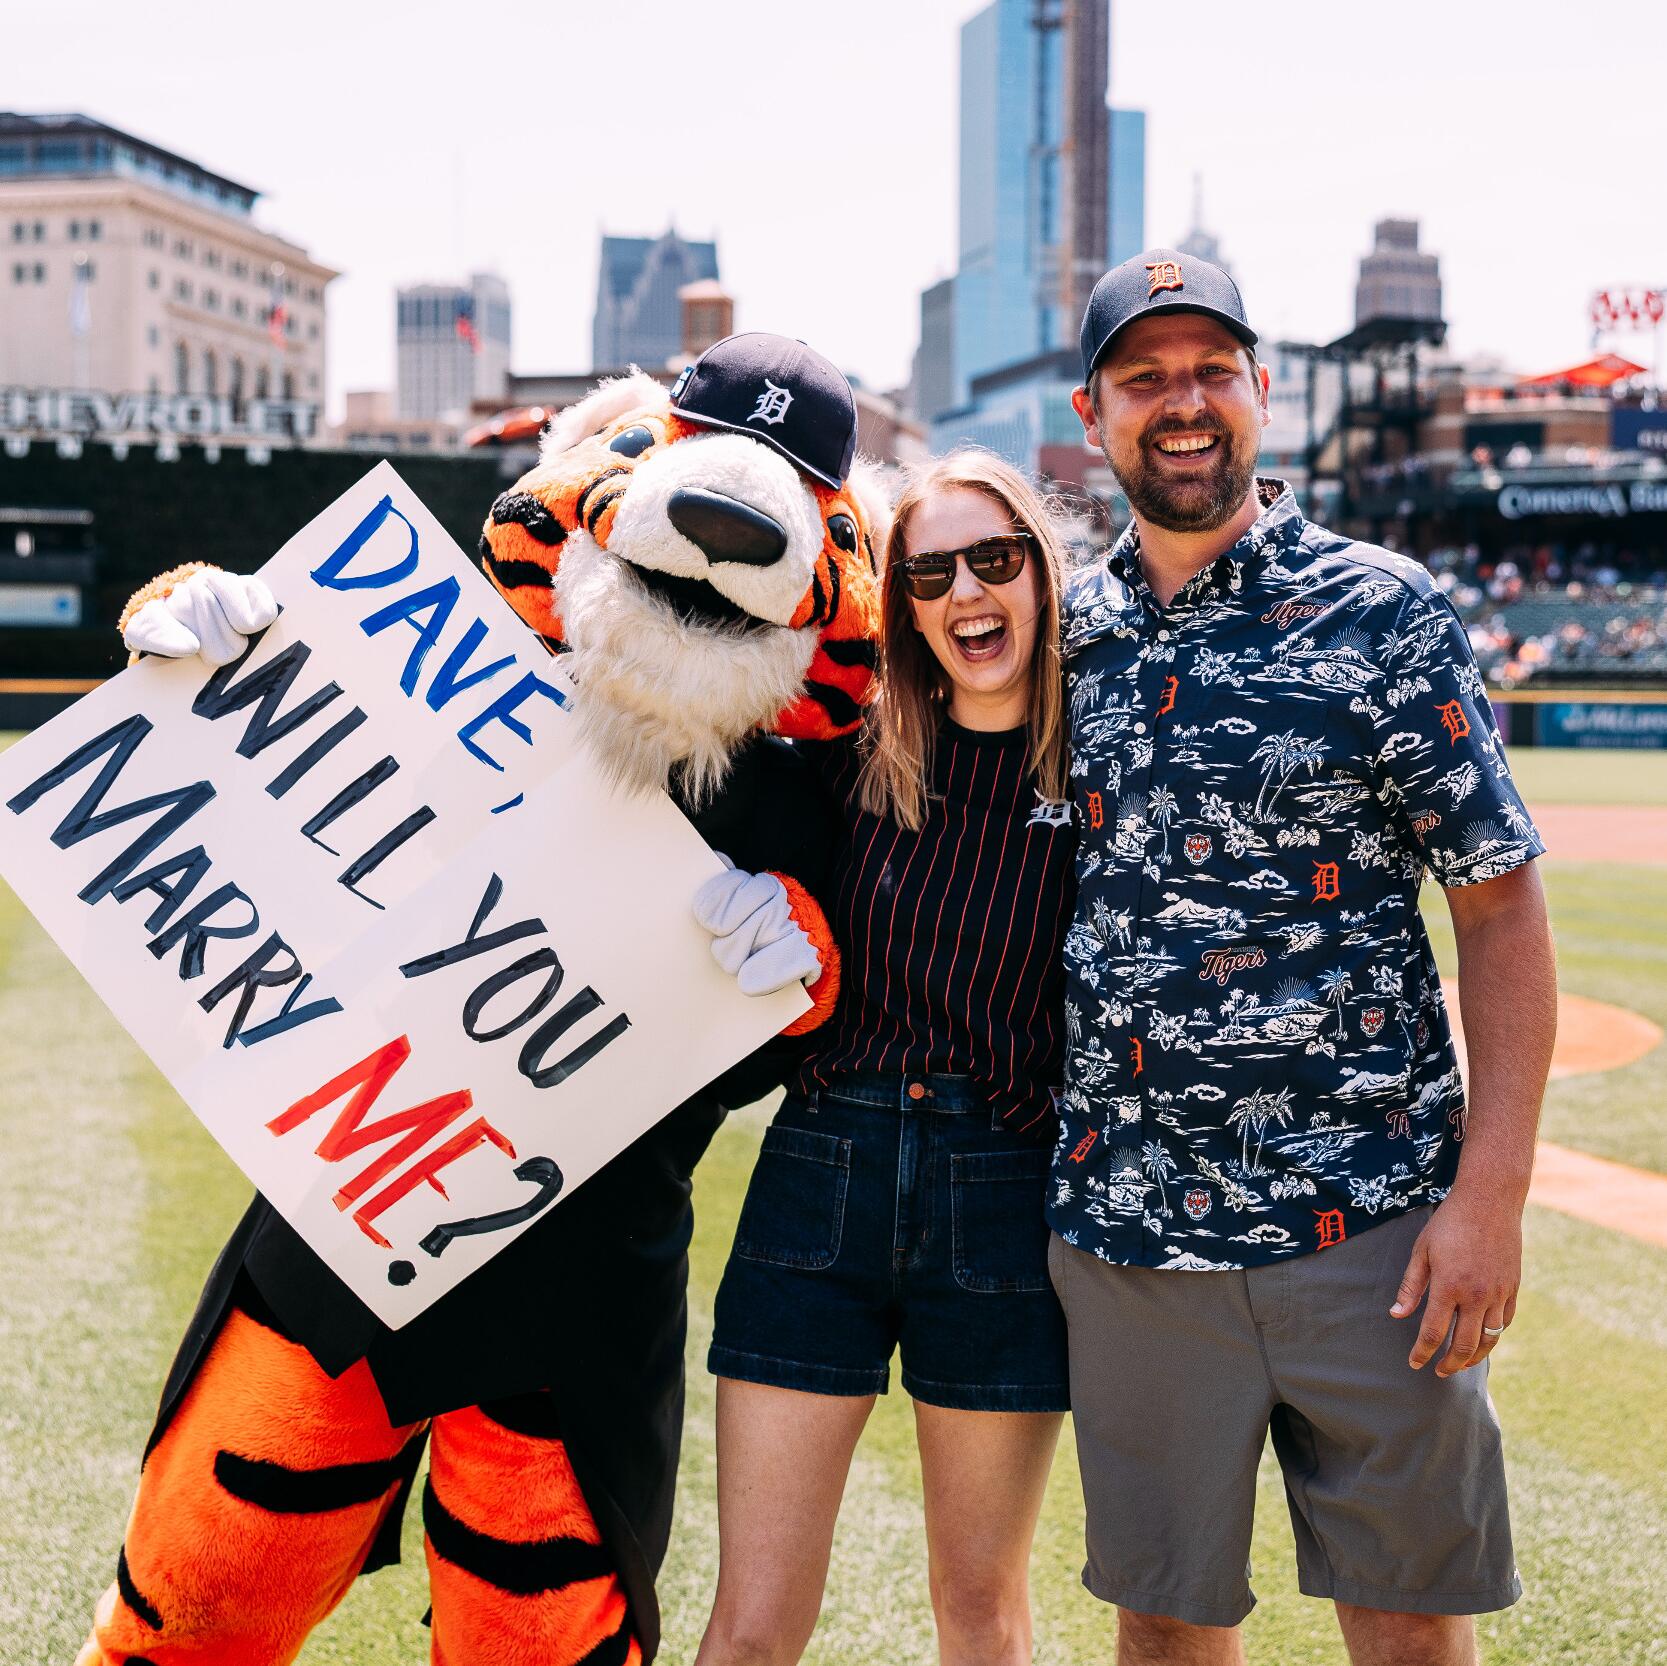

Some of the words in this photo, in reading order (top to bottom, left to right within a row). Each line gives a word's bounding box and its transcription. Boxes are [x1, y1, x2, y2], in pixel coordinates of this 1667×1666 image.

[1146, 260, 1184, 301] D
[0, 390, 317, 437] HEVROLET
[746, 378, 795, 426] D
[311, 494, 573, 814] DAVE,
[1433, 699, 1471, 748] D
[1025, 787, 1073, 829] D
[192, 603, 436, 910] WILL
[398, 872, 632, 1089] YOU
[1311, 859, 1341, 905] D
[1199, 947, 1267, 987] Tigers
[7, 714, 344, 1049] MARRY
[264, 1034, 564, 1287] ME?
[1312, 1208, 1346, 1251] D
